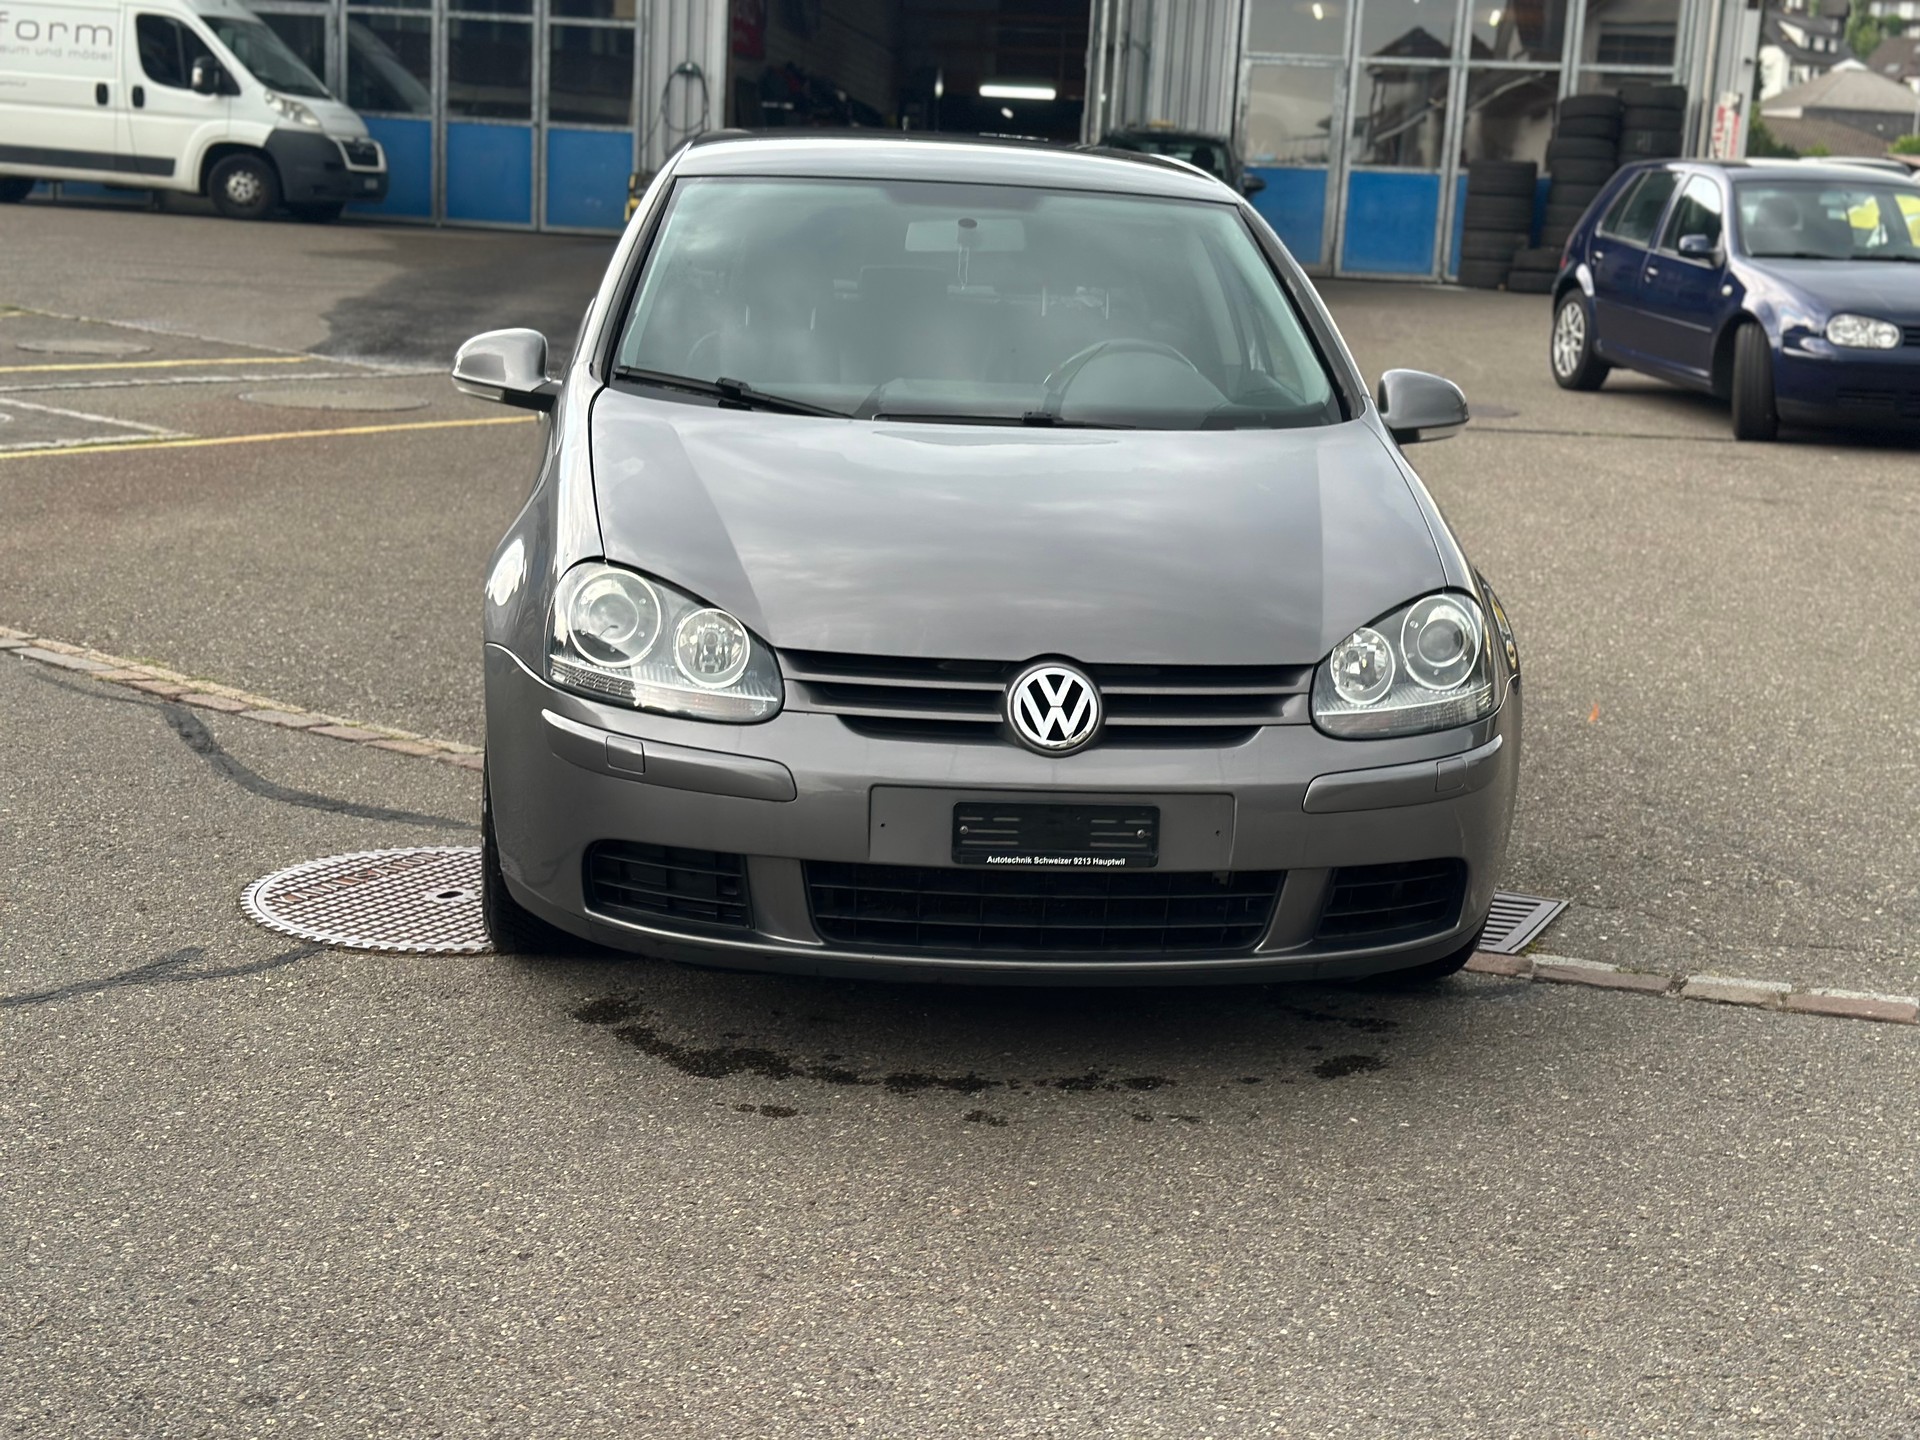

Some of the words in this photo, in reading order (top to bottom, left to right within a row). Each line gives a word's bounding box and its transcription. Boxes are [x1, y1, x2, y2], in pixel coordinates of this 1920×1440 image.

[35, 46, 63, 58] und
[1013, 666, 1098, 747] VW
[986, 855, 1032, 865] Autotechnik
[1033, 856, 1072, 866] Schweizer
[1073, 856, 1092, 866] 9213
[1092, 857, 1126, 867] Hauptwil
